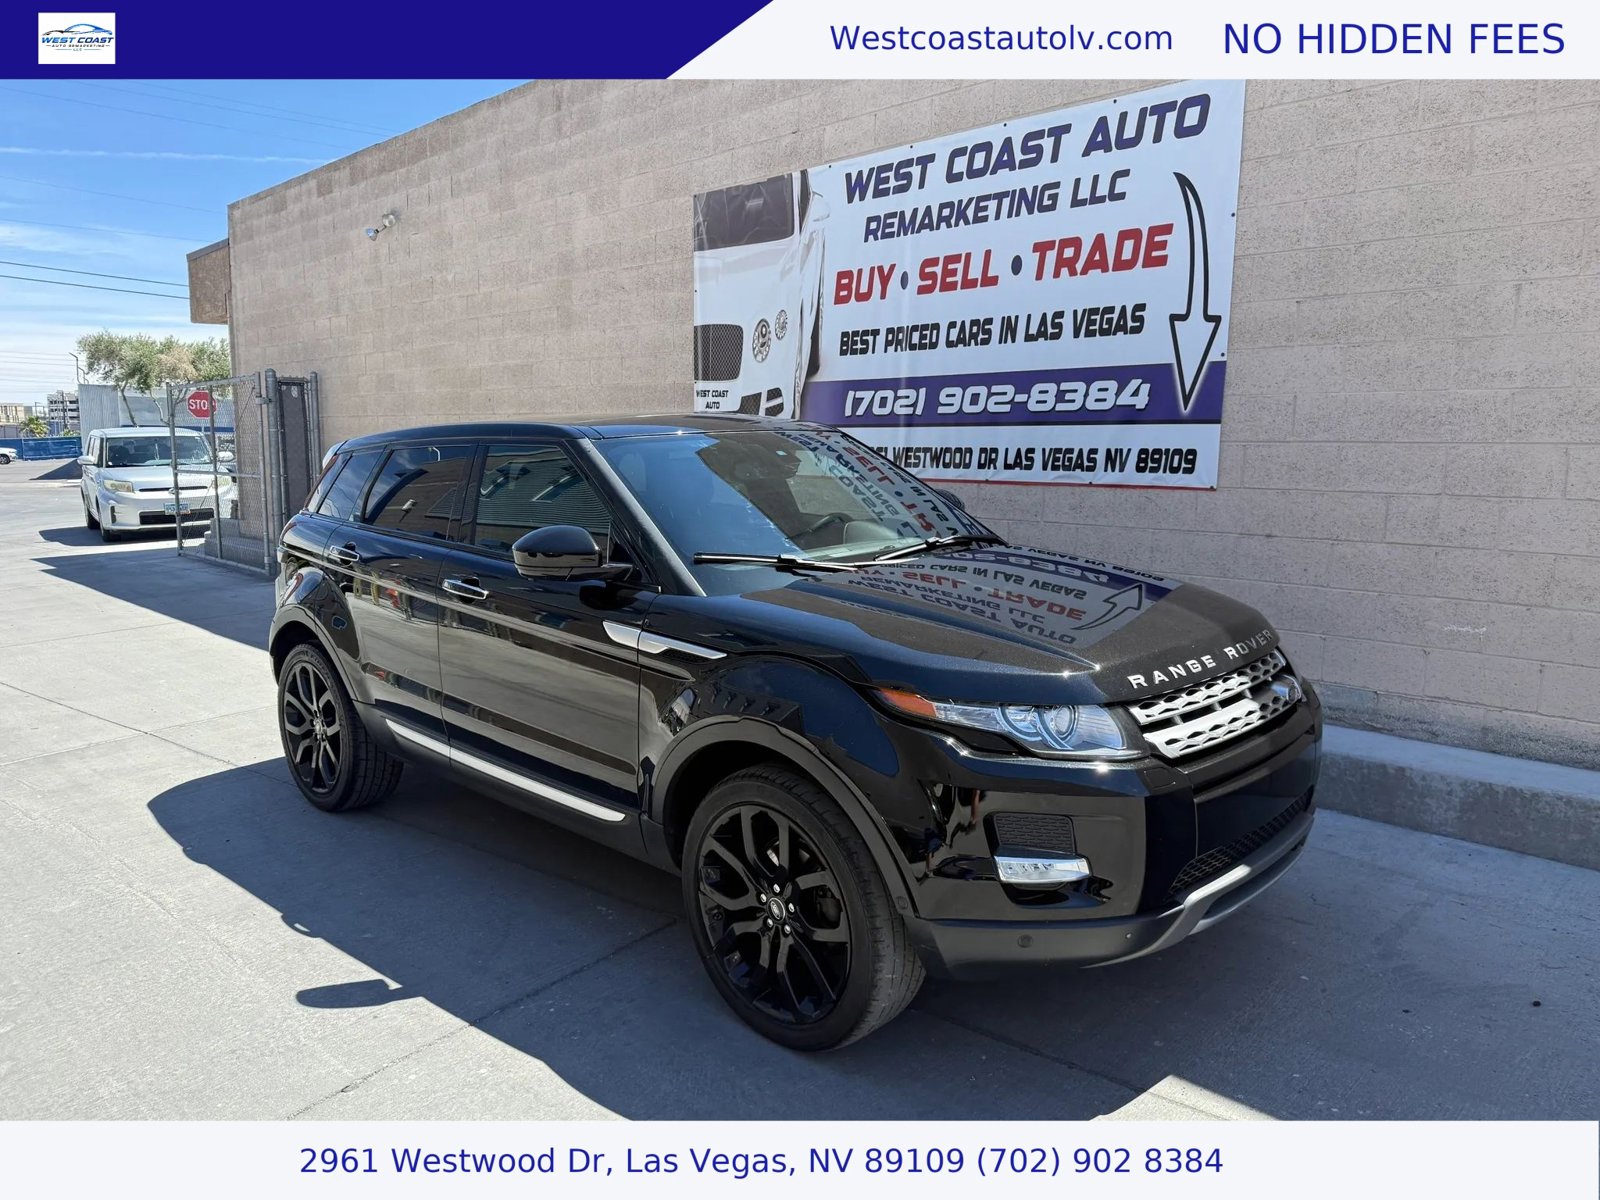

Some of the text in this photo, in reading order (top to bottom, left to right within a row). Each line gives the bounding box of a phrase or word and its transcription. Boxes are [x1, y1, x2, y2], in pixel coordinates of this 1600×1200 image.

[845, 94, 1211, 204] WEST COAST AUTO
[864, 168, 1131, 243] REMARKETING LLC
[834, 223, 1174, 306] BUY SELL TRADE
[839, 302, 1147, 356] BEST PRICED CARS IN LAS VEGAS
[189, 399, 214, 411] STO
[696, 390, 728, 398] WEST COAST
[936, 378, 1150, 414] 902-8384
[892, 446, 972, 469] WESTWOOD
[977, 447, 998, 470] DR
[1003, 448, 1036, 470] LAS
[1042, 448, 1098, 472] VEGAS
[1104, 448, 1132, 472] NV
[1135, 448, 1198, 474] 89109
[1126, 630, 1274, 689] RANGE ROVER
